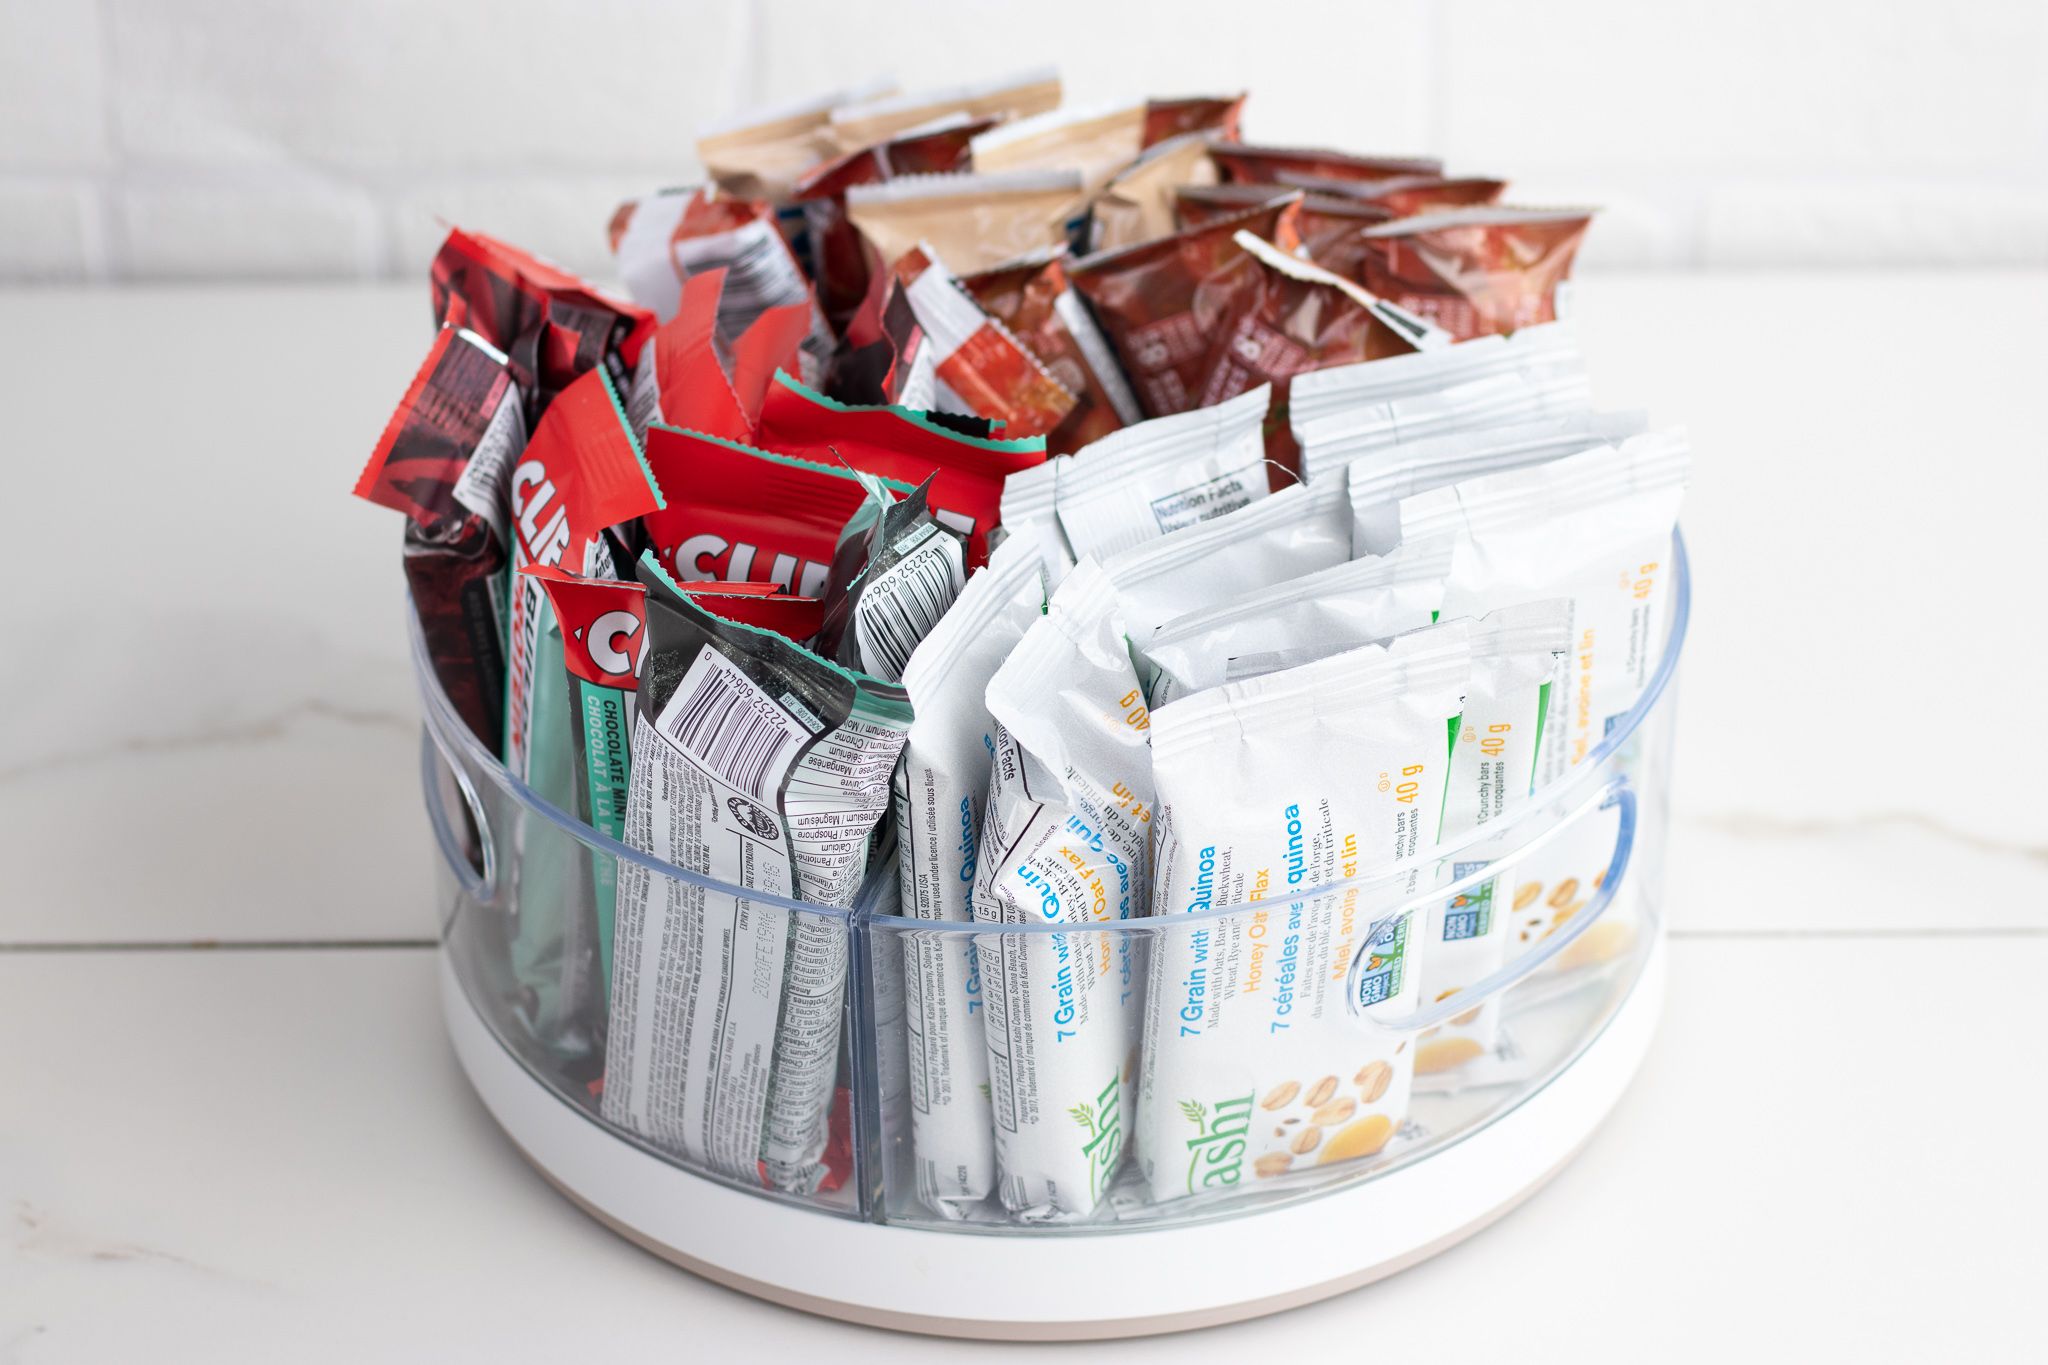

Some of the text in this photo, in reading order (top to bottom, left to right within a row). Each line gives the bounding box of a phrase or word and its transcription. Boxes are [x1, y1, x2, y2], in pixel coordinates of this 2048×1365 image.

[512, 460, 570, 567] CLIF
[862, 549, 933, 609] 22252 60644
[704, 651, 713, 661] 0
[723, 668, 754, 698] 60644
[1119, 689, 1140, 708] g
[752, 696, 787, 730] 22252
[587, 694, 608, 778] CHOCOLAT
[834, 732, 864, 749] Chrome
[1481, 723, 1511, 757] 40 g
[603, 700, 627, 821] CHOCOLATE MINT
[808, 756, 853, 775] Manganèse
[828, 746, 864, 763] Sélénium
[1001, 748, 1017, 781] Facts
[1065, 765, 1106, 808] triticale
[1396, 764, 1424, 804] 40 g
[1478, 761, 1490, 820] Crunchy bars
[1494, 761, 1504, 809] croquantes
[597, 798, 610, 817] LA
[1104, 805, 1119, 820] du
[1112, 783, 1151, 823] et lin
[797, 810, 883, 826] agnesium Magnésium
[1318, 797, 1335, 848] triticale
[1396, 811, 1405, 833] bars
[797, 828, 838, 840] Phosphore
[925, 788, 940, 899] used under licence utilisée sous
[957, 796, 976, 882] Quinoa
[1108, 828, 1121, 842] de
[1408, 808, 1418, 857] croquantes
[821, 842, 851, 852] Calcium
[1340, 833, 1358, 859] lin
[1323, 850, 1335, 866] du
[1343, 860, 1357, 878] et
[745, 875, 755, 889] DATE
[918, 874, 928, 889] USA
[1045, 856, 1085, 902] Triticale
[1057, 846, 1106, 915] Oat Flax
[1106, 853, 1129, 894] avec
[919, 889, 930, 908] 92075
[739, 911, 750, 930] EXPIRY
[920, 908, 930, 919] CA
[978, 906, 990, 916] 1.5
[1271, 803, 1309, 1034] 7 céréales quinoa
[799, 932, 832, 943] Thiamine
[1207, 845, 1234, 1030] Made with Oats, Buckwheat,
[1243, 867, 1270, 993] Honey Flax
[796, 954, 828, 965] Vitamine
[797, 943, 829, 954] Vitamine
[1007, 949, 1018, 971] Beach,
[794, 965, 826, 975] Vitamine
[1017, 961, 1028, 979] Kashi
[1332, 942, 1353, 982] Miel,
[793, 975, 825, 985] Vitamine
[924, 970, 936, 1001] Company,
[1009, 972, 1019, 995] Solana
[1019, 980, 1029, 989] de
[1075, 969, 1087, 993] with
[1223, 961, 1240, 1001] Wheat,
[1371, 975, 1383, 1003] GMO
[793, 995, 828, 1006] Protéines
[1051, 965, 1076, 1025] Grain
[1180, 967, 1207, 1022] Grain
[1361, 979, 1373, 1005] NON
[925, 1001, 936, 1020] Kashi
[934, 952, 951, 1077] Trademark of marque de commerce de
[968, 1001, 983, 1015] 7
[1011, 996, 1022, 1026] Company,
[1021, 990, 1031, 1022] commerce
[1078, 994, 1089, 1025] Made
[928, 1020, 938, 1036] pour
[1012, 1026, 1023, 1043] Kashi
[1022, 1023, 1032, 1031] de
[1057, 1029, 1077, 1043] 7
[1180, 1025, 1201, 1037] 7
[1015, 1044, 1025, 1058] pour
[1024, 1032, 1034, 1054] marque
[1015, 1059, 1026, 1083] Préparé
[1026, 1067, 1037, 1097] Trademark
